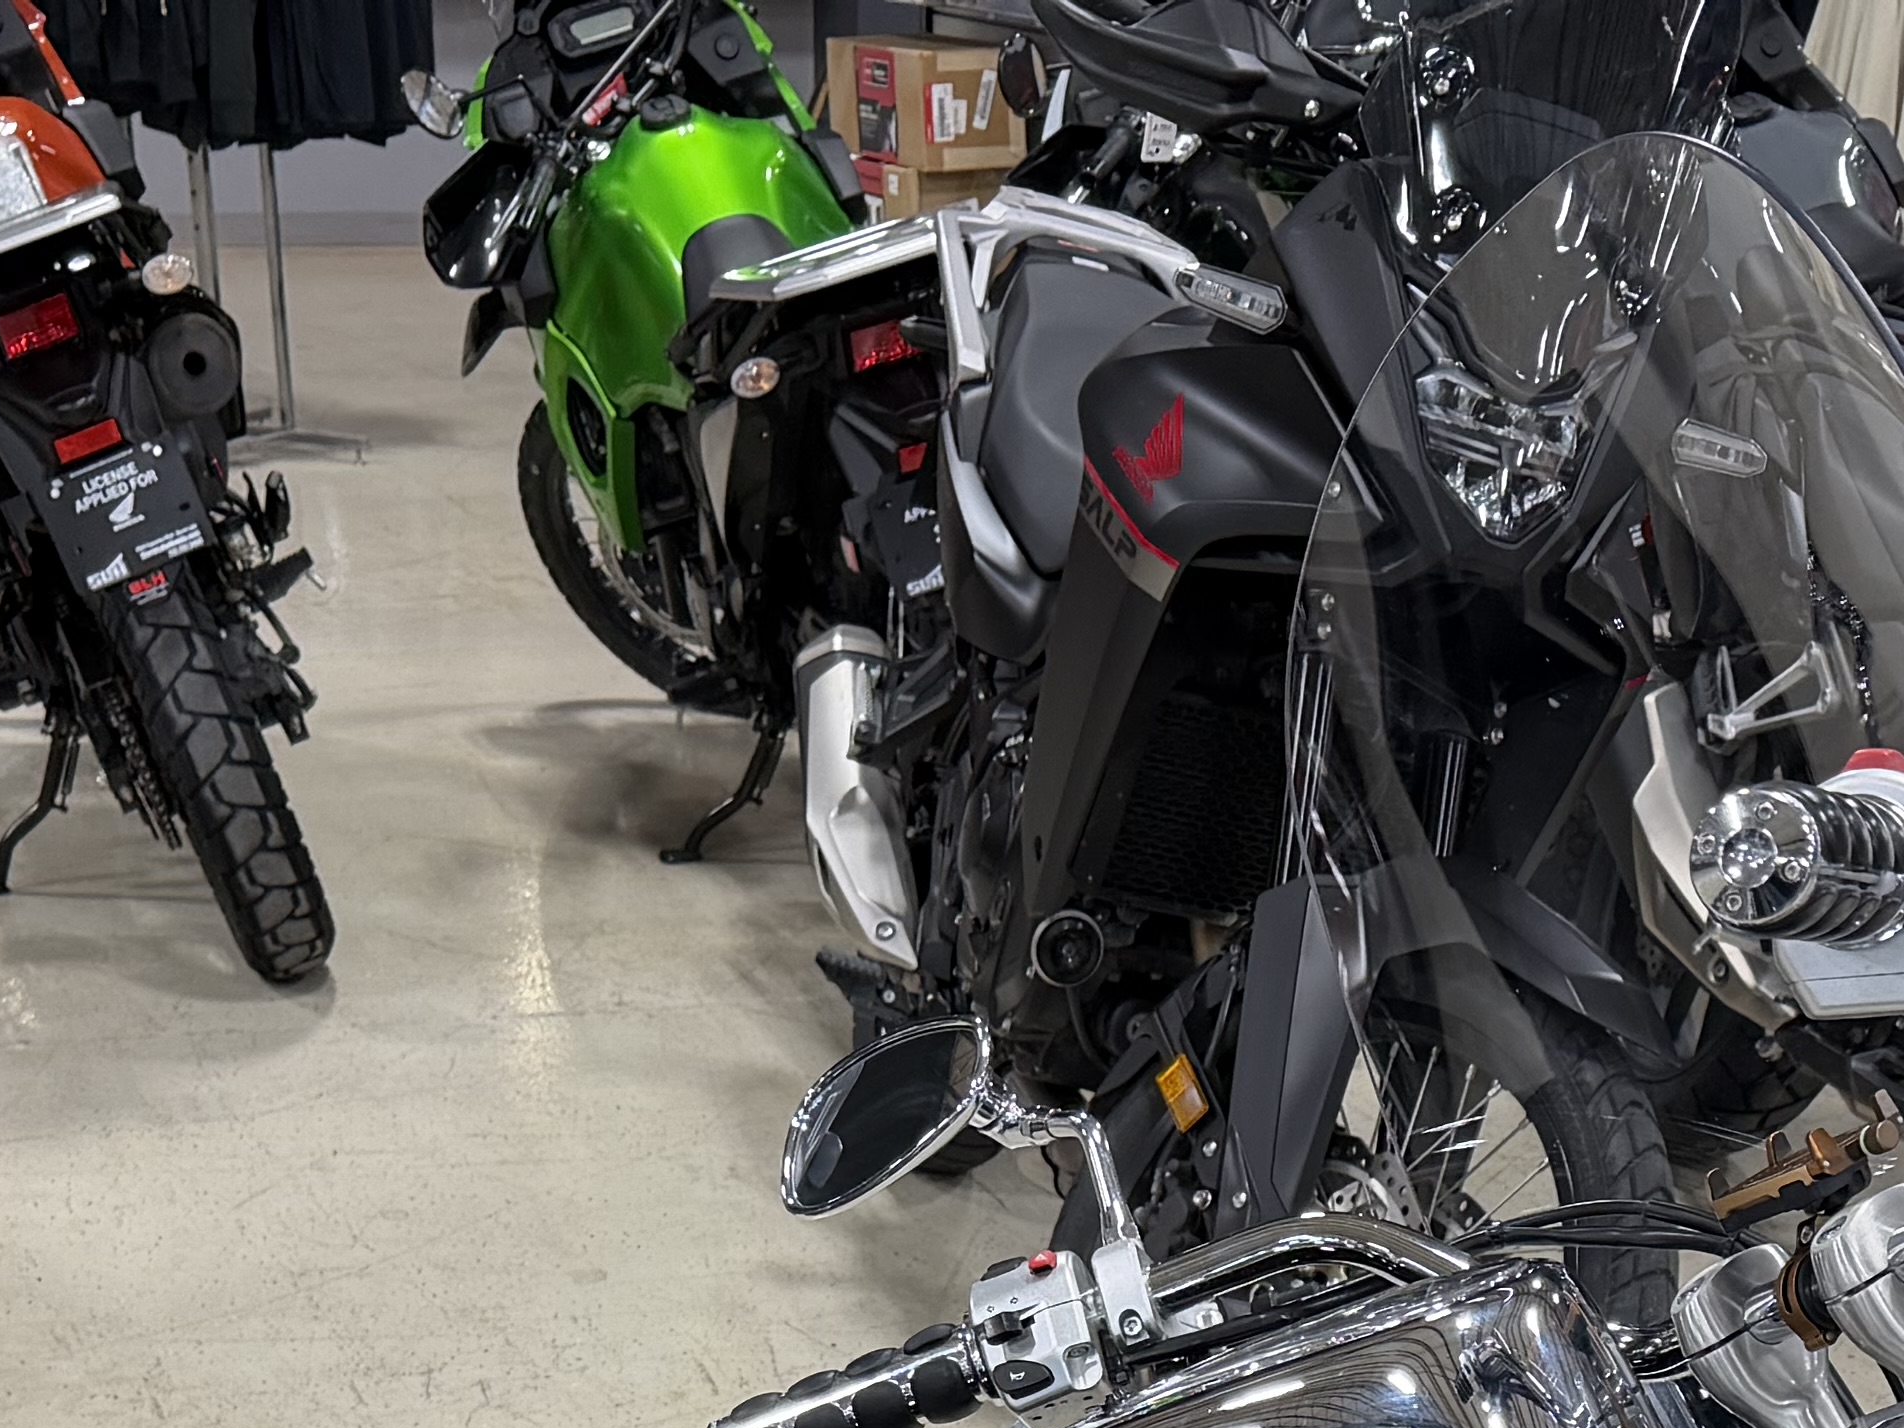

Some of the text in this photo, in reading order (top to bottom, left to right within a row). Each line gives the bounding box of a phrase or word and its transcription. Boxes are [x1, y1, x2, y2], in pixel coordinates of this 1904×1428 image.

[75, 469, 159, 515] APPLIED FOR
[81, 461, 139, 494] LICENSE
